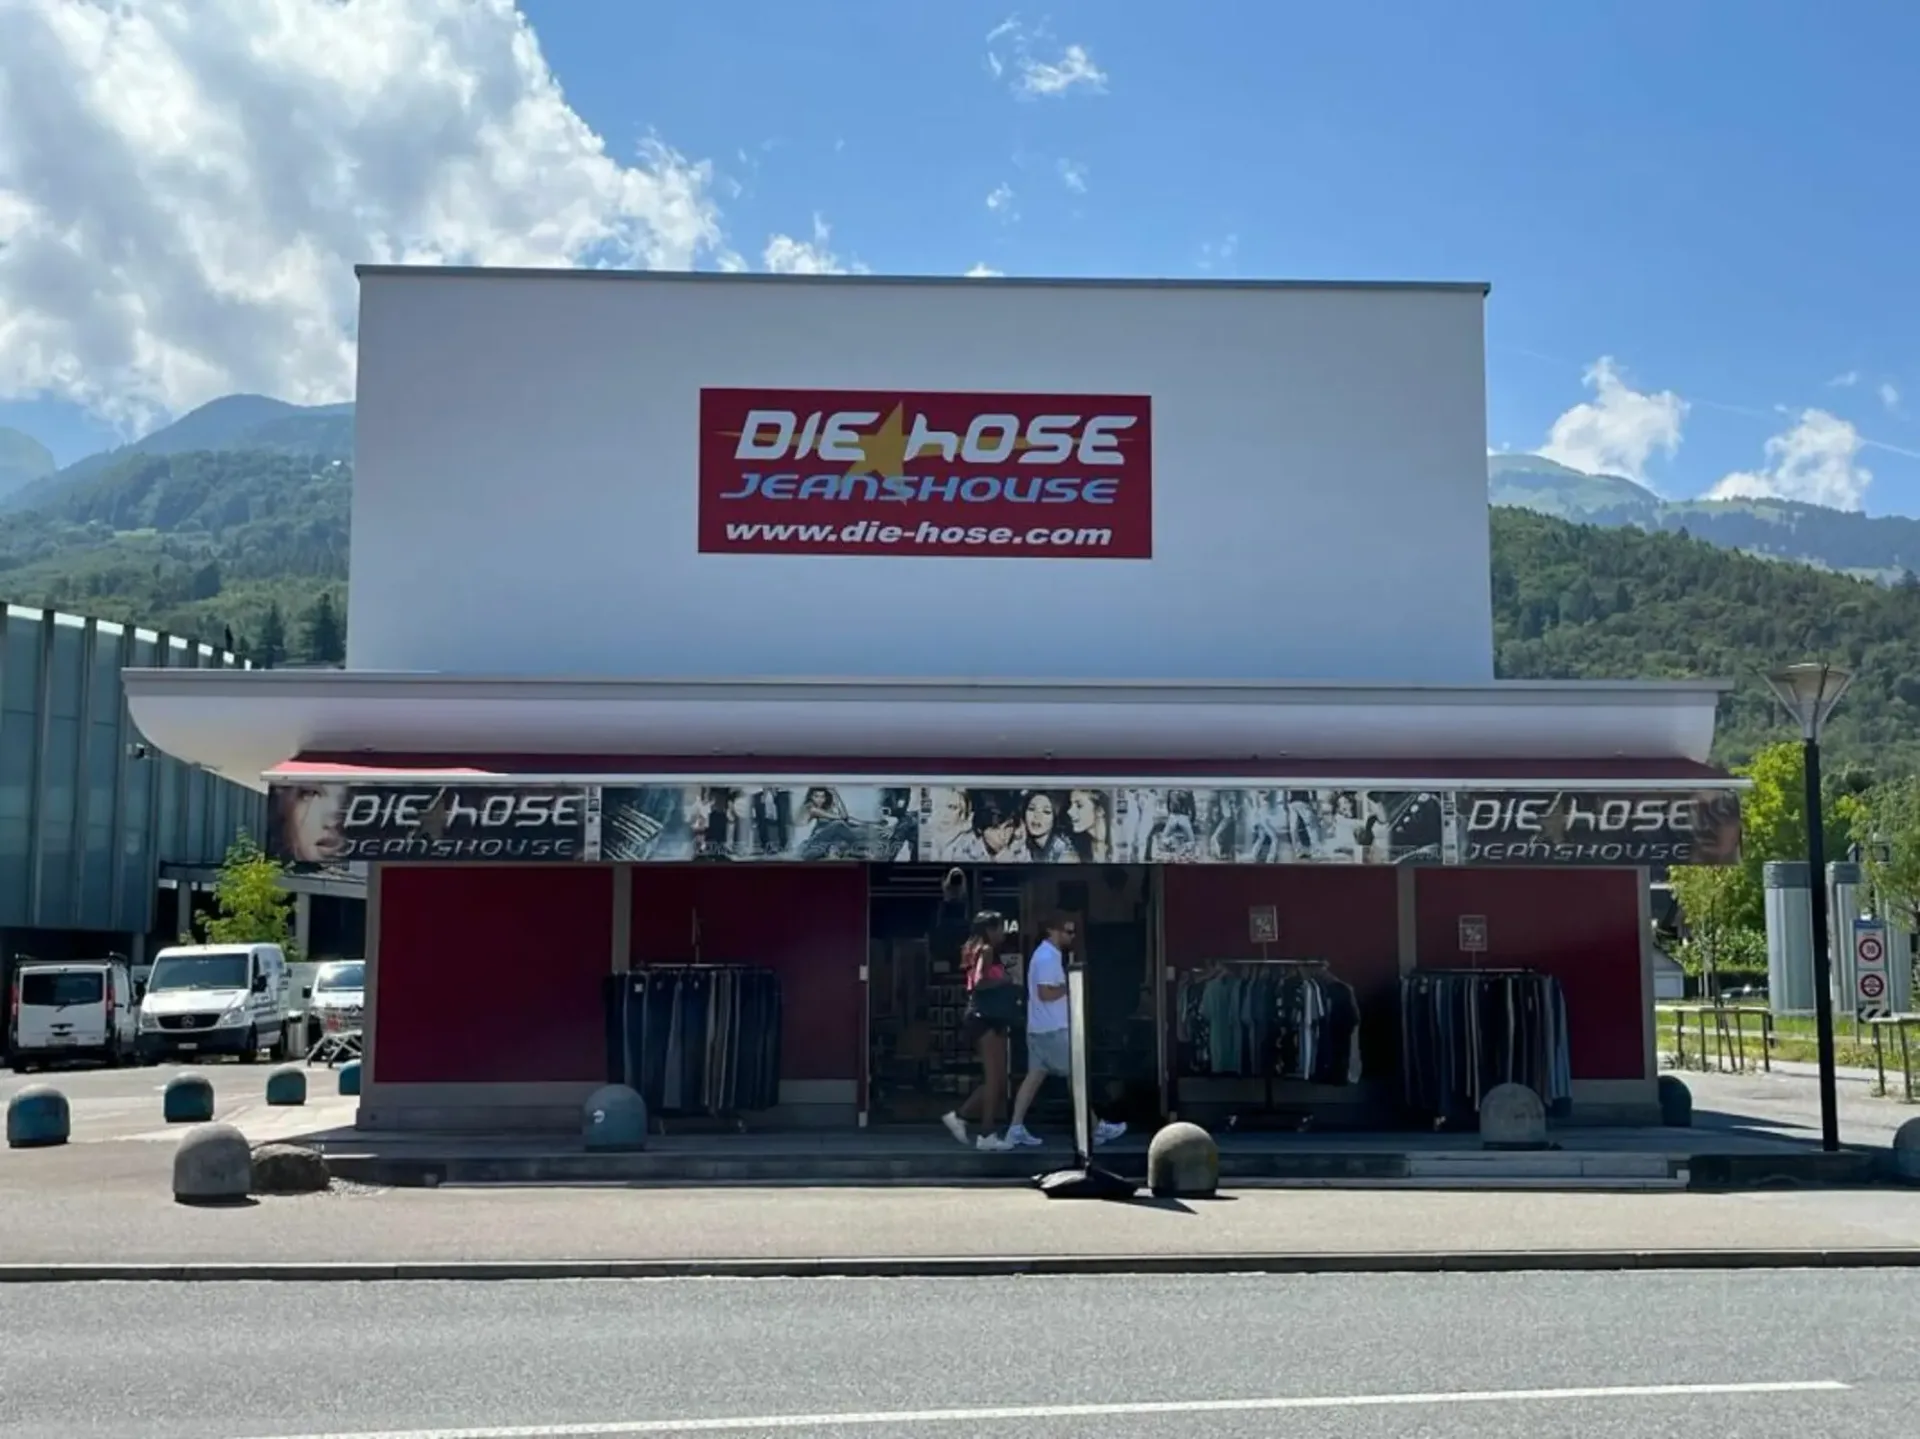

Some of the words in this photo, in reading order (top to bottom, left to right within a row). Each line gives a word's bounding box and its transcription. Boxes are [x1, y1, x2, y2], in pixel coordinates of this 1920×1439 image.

[734, 409, 880, 461] DIE
[725, 521, 1112, 546] www.die-hose.com
[344, 793, 432, 827] DIE
[1467, 798, 1549, 832] DIE
